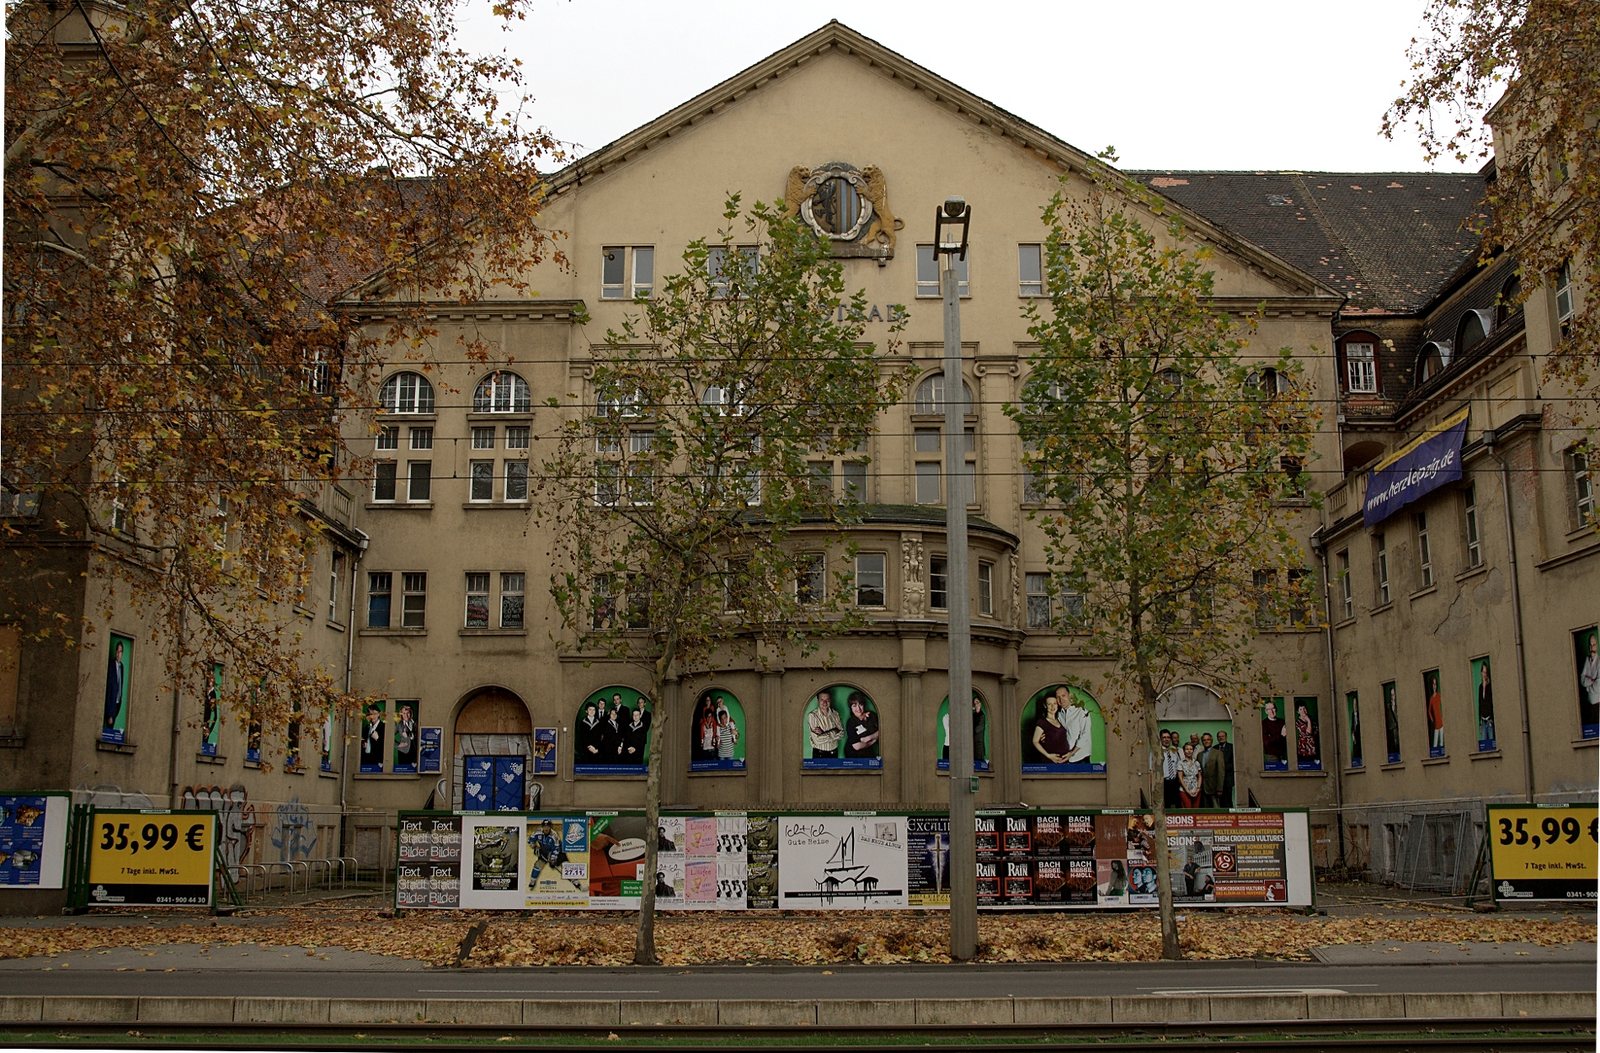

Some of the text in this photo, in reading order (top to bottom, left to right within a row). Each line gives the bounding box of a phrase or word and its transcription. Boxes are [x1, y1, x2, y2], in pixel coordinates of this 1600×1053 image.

[1166, 815, 1194, 824] SIONS
[401, 820, 422, 831] Text
[432, 820, 453, 831] Text
[1499, 817, 1580, 849] 35,99
[101, 823, 204, 855] 35,99 €
[400, 846, 429, 857] Bilder
[430, 846, 460, 857] Bilder
[127, 867, 141, 876] Tage
[400, 866, 420, 876] Text
[430, 866, 451, 876] Text
[398, 892, 428, 903] Bilder
[429, 892, 458, 903] Bilder
